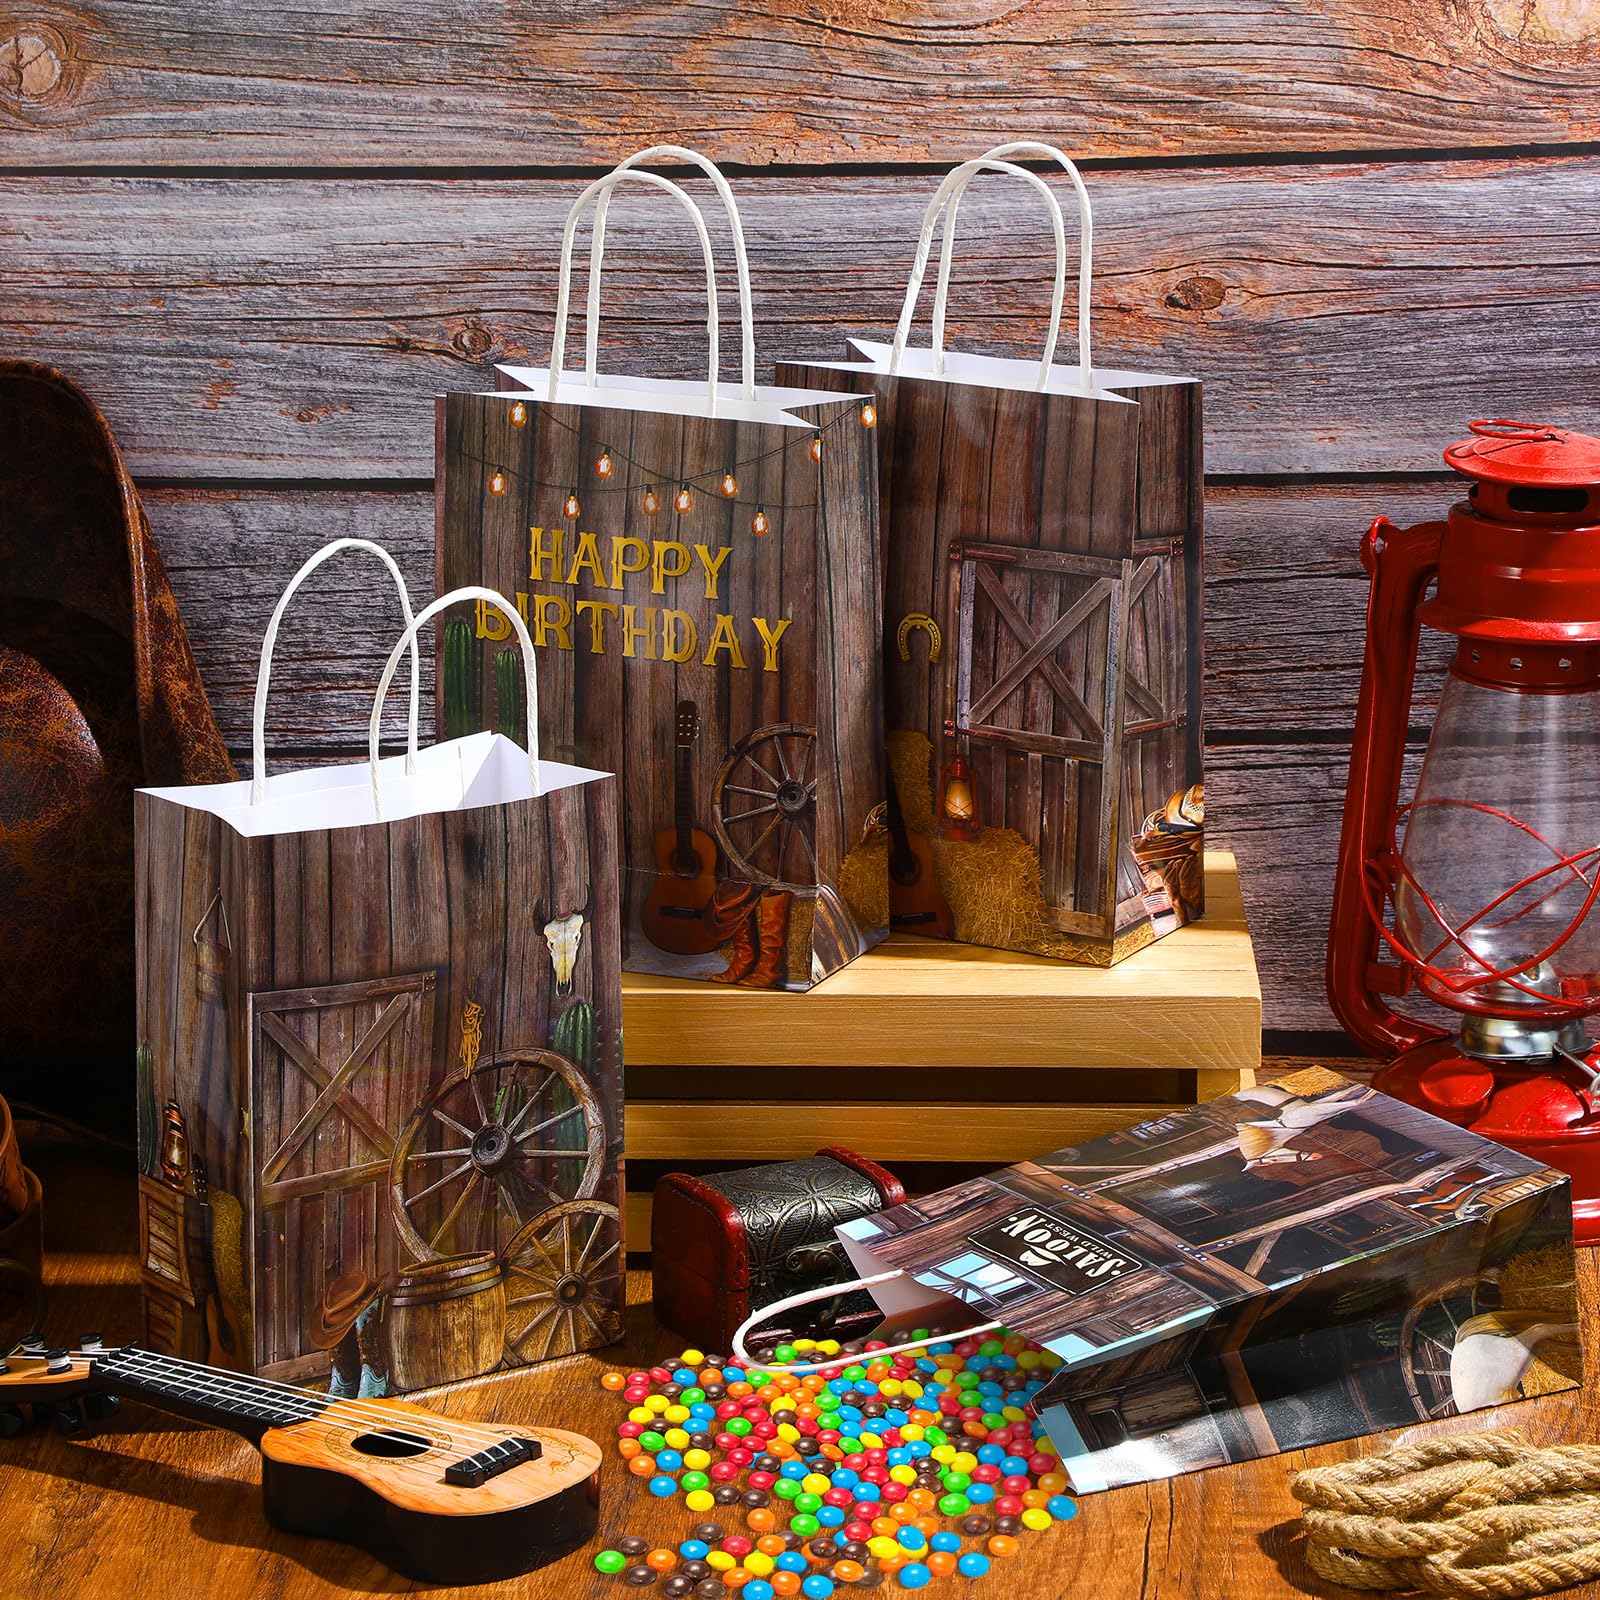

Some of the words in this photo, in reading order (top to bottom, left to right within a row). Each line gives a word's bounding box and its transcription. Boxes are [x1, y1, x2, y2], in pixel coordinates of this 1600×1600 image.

[529, 527, 734, 599] HAPPY
[475, 592, 792, 671] BIRTHDAY
[1001, 1214, 1126, 1278] SALOON
[1045, 1223, 1079, 1242] WEST
[1081, 1240, 1113, 1259] WILD
